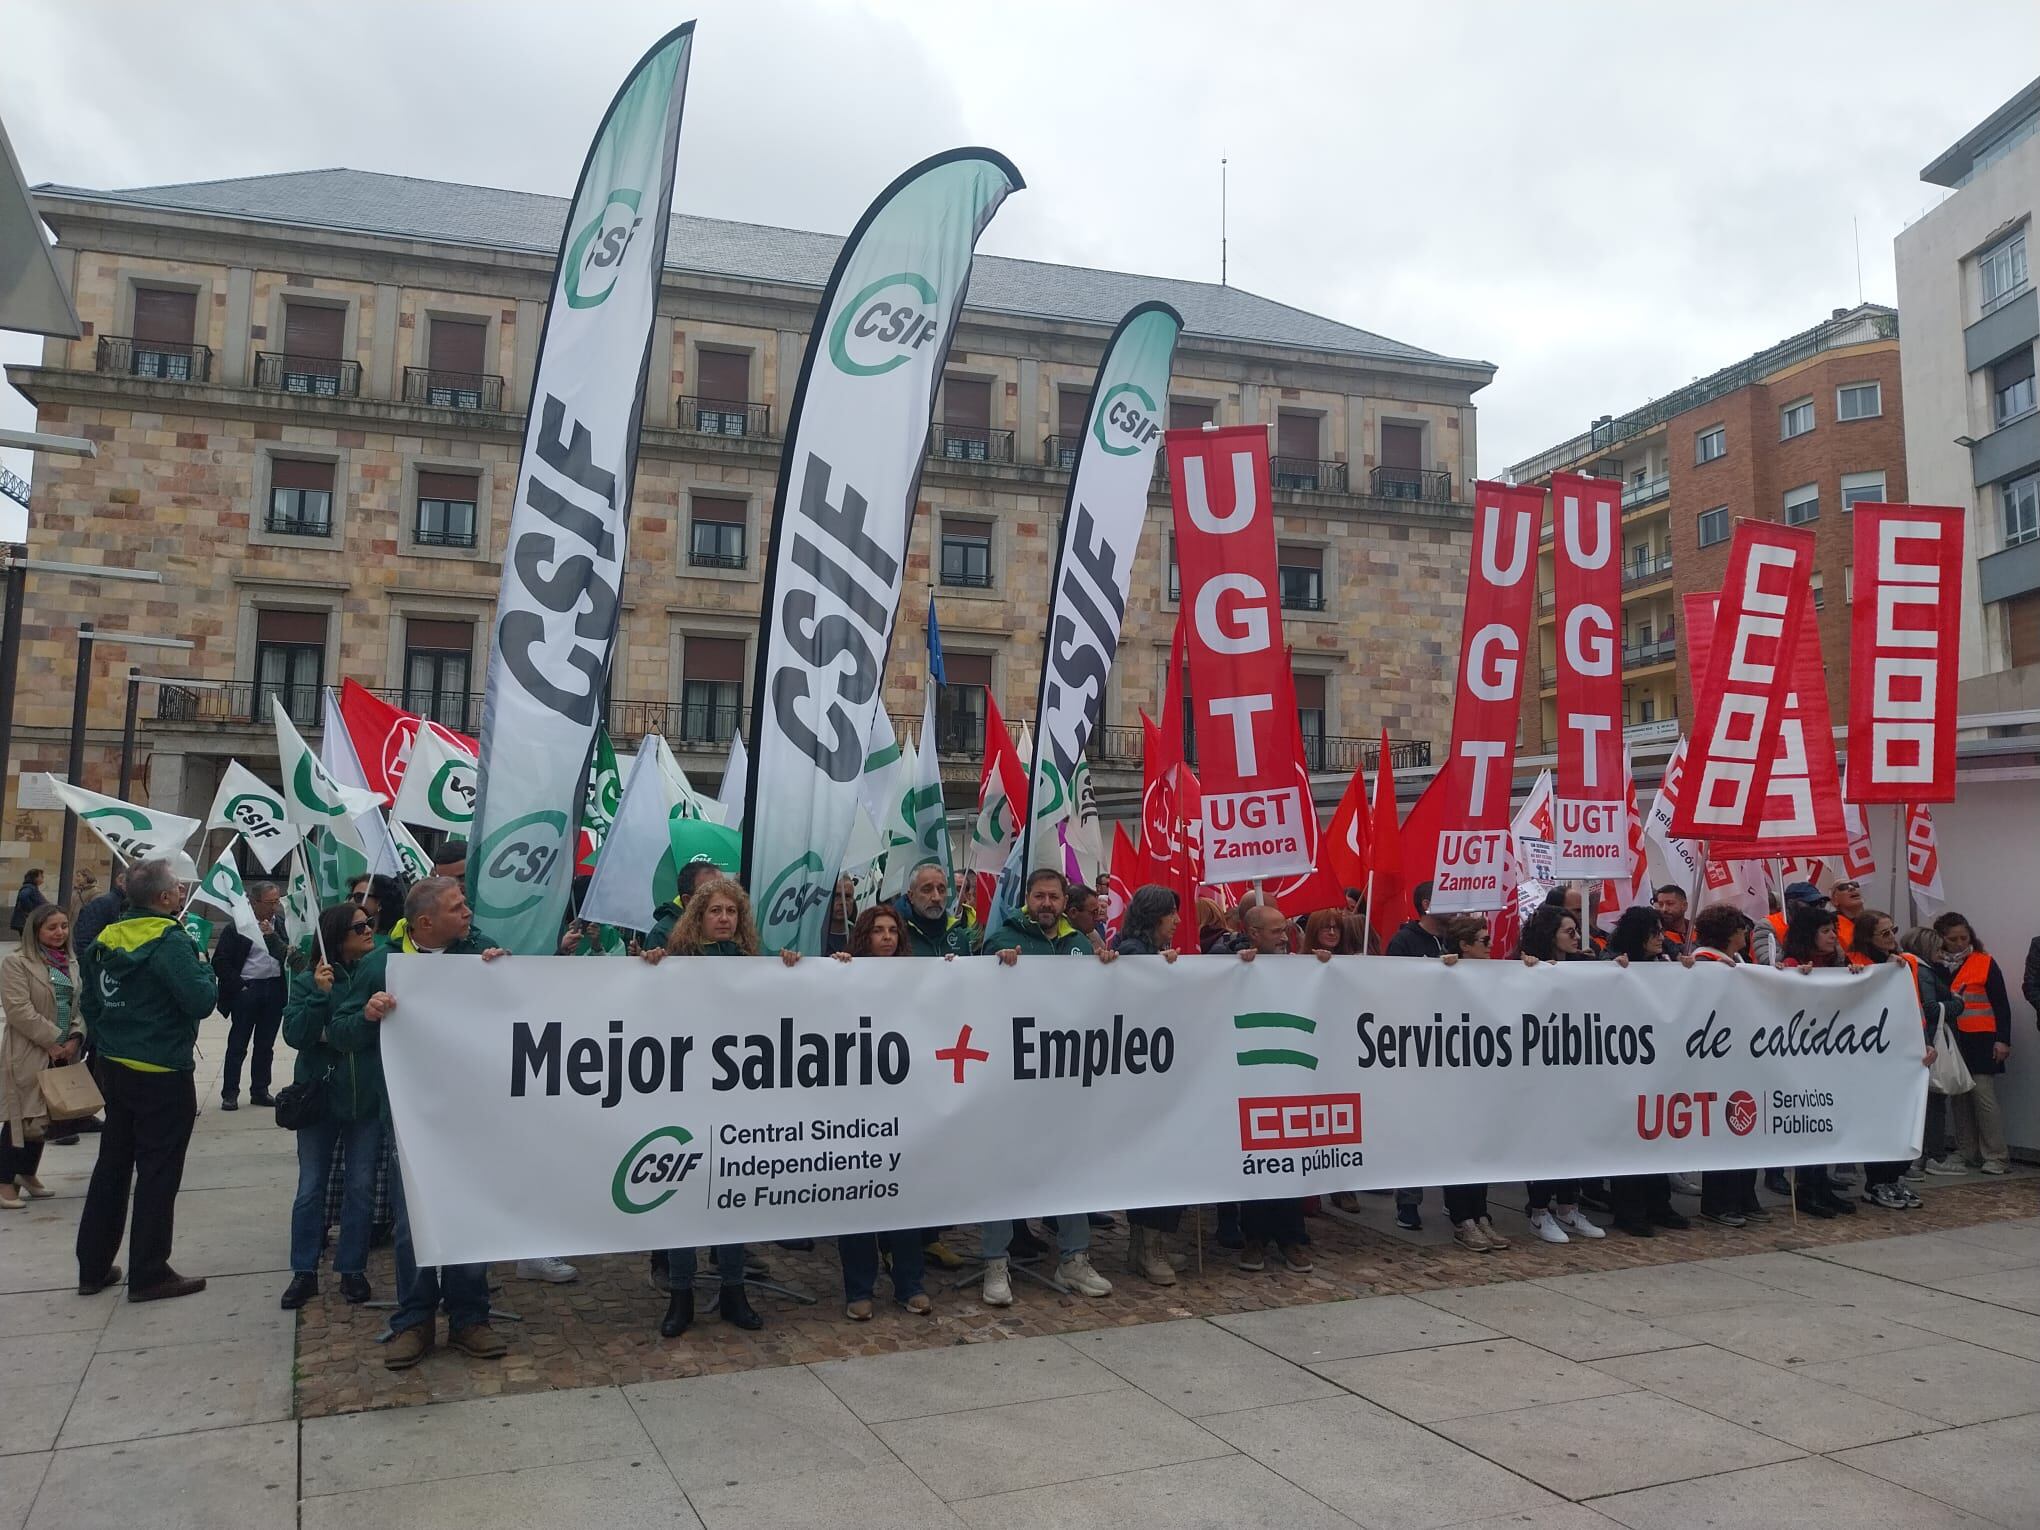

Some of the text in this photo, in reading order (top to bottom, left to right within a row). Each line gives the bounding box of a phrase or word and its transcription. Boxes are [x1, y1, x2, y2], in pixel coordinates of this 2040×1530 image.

[854, 302, 937, 350] CSIF
[1108, 401, 1161, 445] CSIF
[500, 392, 618, 727] CSIF
[772, 451, 899, 783] CSIF
[1183, 452, 1273, 778] UGT
[1047, 502, 1126, 786] CSIF
[1563, 496, 1614, 788] UGT
[1872, 519, 1941, 784] CCOO
[1461, 506, 1531, 817] UGT
[1693, 543, 1797, 826] CCOO
[236, 804, 280, 838] CSIF
[1210, 792, 1291, 831] UGT
[1563, 804, 1618, 833] UGT
[489, 841, 559, 886] CSI
[1213, 837, 1298, 860] Zamora
[1442, 834, 1501, 865] UGT
[1562, 840, 1620, 858] Zamora
[1438, 873, 1496, 891] Zamora
[510, 1020, 693, 1108] Mejor
[711, 1016, 911, 1091] salario
[1012, 1014, 1175, 1087] Empleo
[1357, 1012, 1512, 1068] Servicios
[1521, 1012, 1656, 1067] Públicos
[1685, 1010, 1733, 1060] de
[1750, 1007, 1891, 1057] calidad
[1637, 1091, 1718, 1141] UGT
[1772, 1089, 1834, 1109] Servicios
[719, 1117, 900, 1145] Central Sindical
[1248, 1103, 1354, 1140] CCOO
[1772, 1114, 1834, 1135] Públicos
[630, 1152, 704, 1185] CSIF
[719, 1152, 901, 1179] Independiente y
[1242, 1148, 1364, 1177] área pública
[716, 1180, 900, 1209] de Funcionarios
